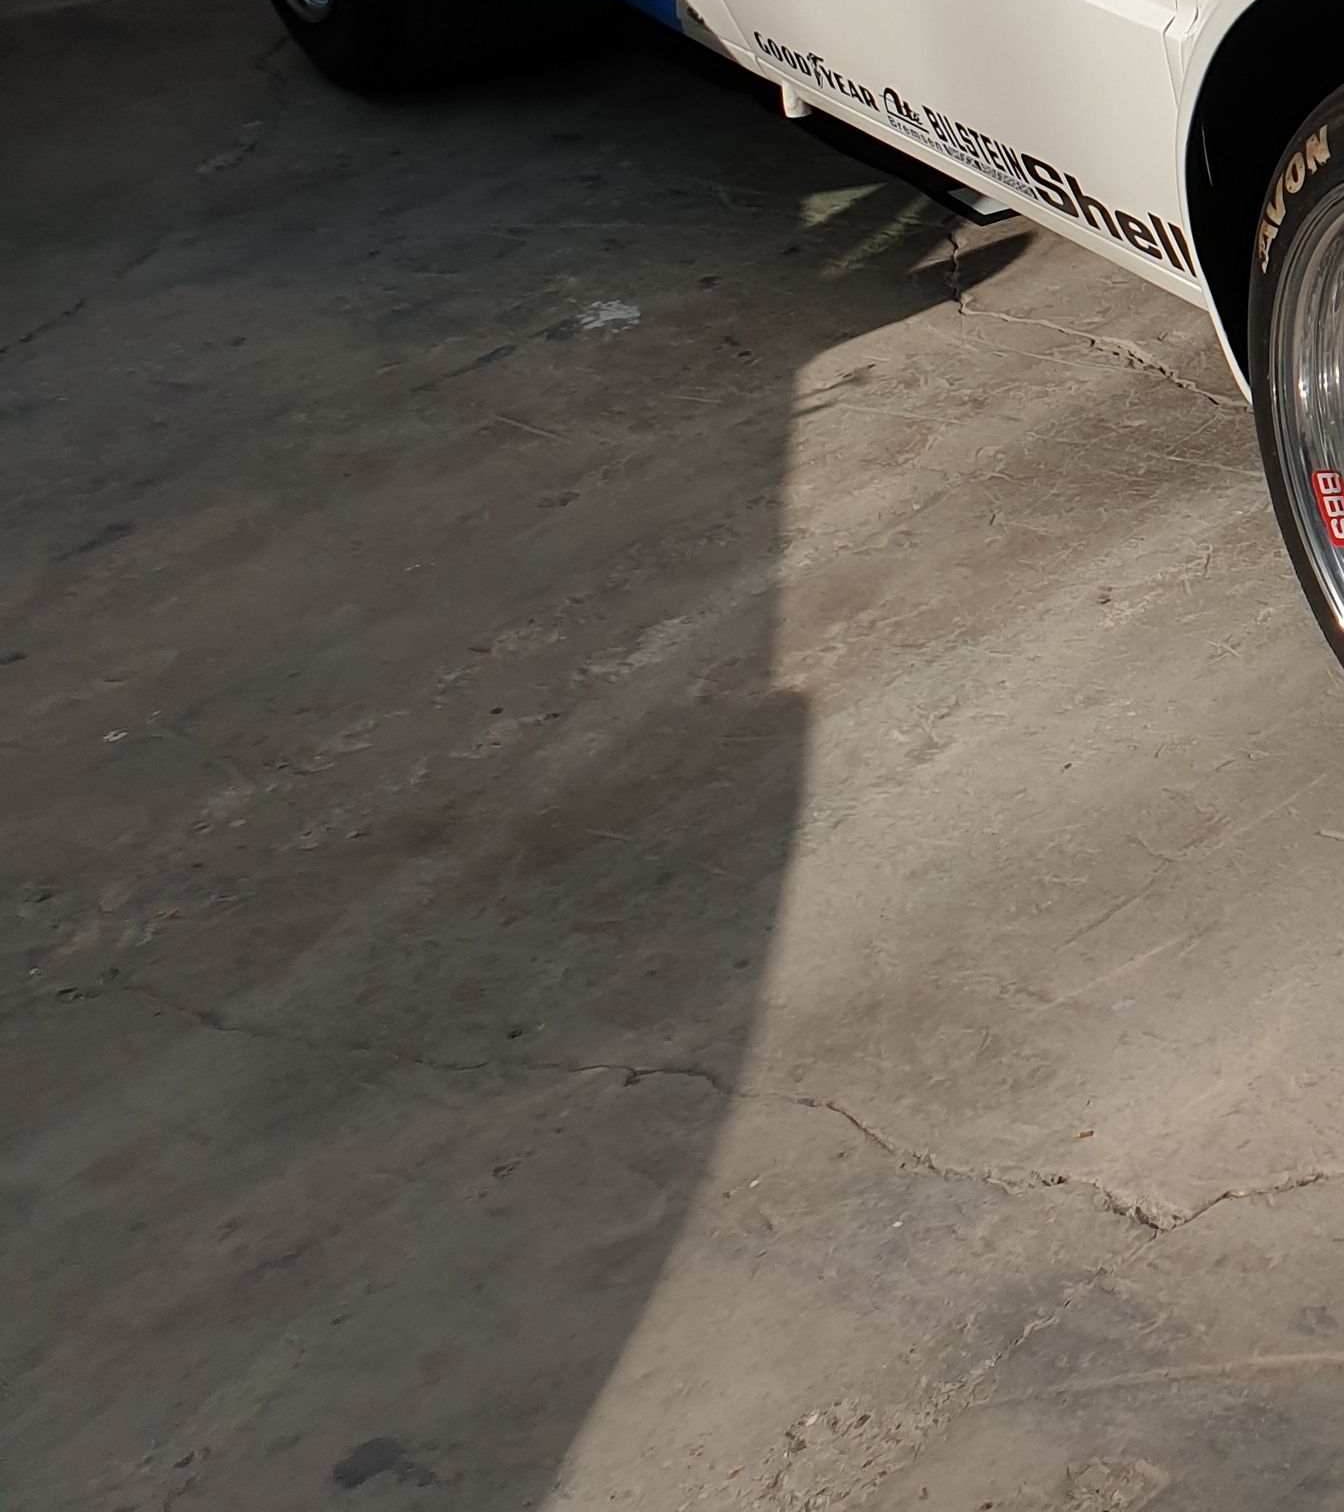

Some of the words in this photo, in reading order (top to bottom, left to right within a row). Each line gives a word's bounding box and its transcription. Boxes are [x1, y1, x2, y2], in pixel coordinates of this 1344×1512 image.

[754, 31, 880, 112] GOODYEAR
[922, 104, 1030, 185] BILSTEIN
[1021, 152, 1199, 278] Shell
[1258, 124, 1331, 275] AVON
